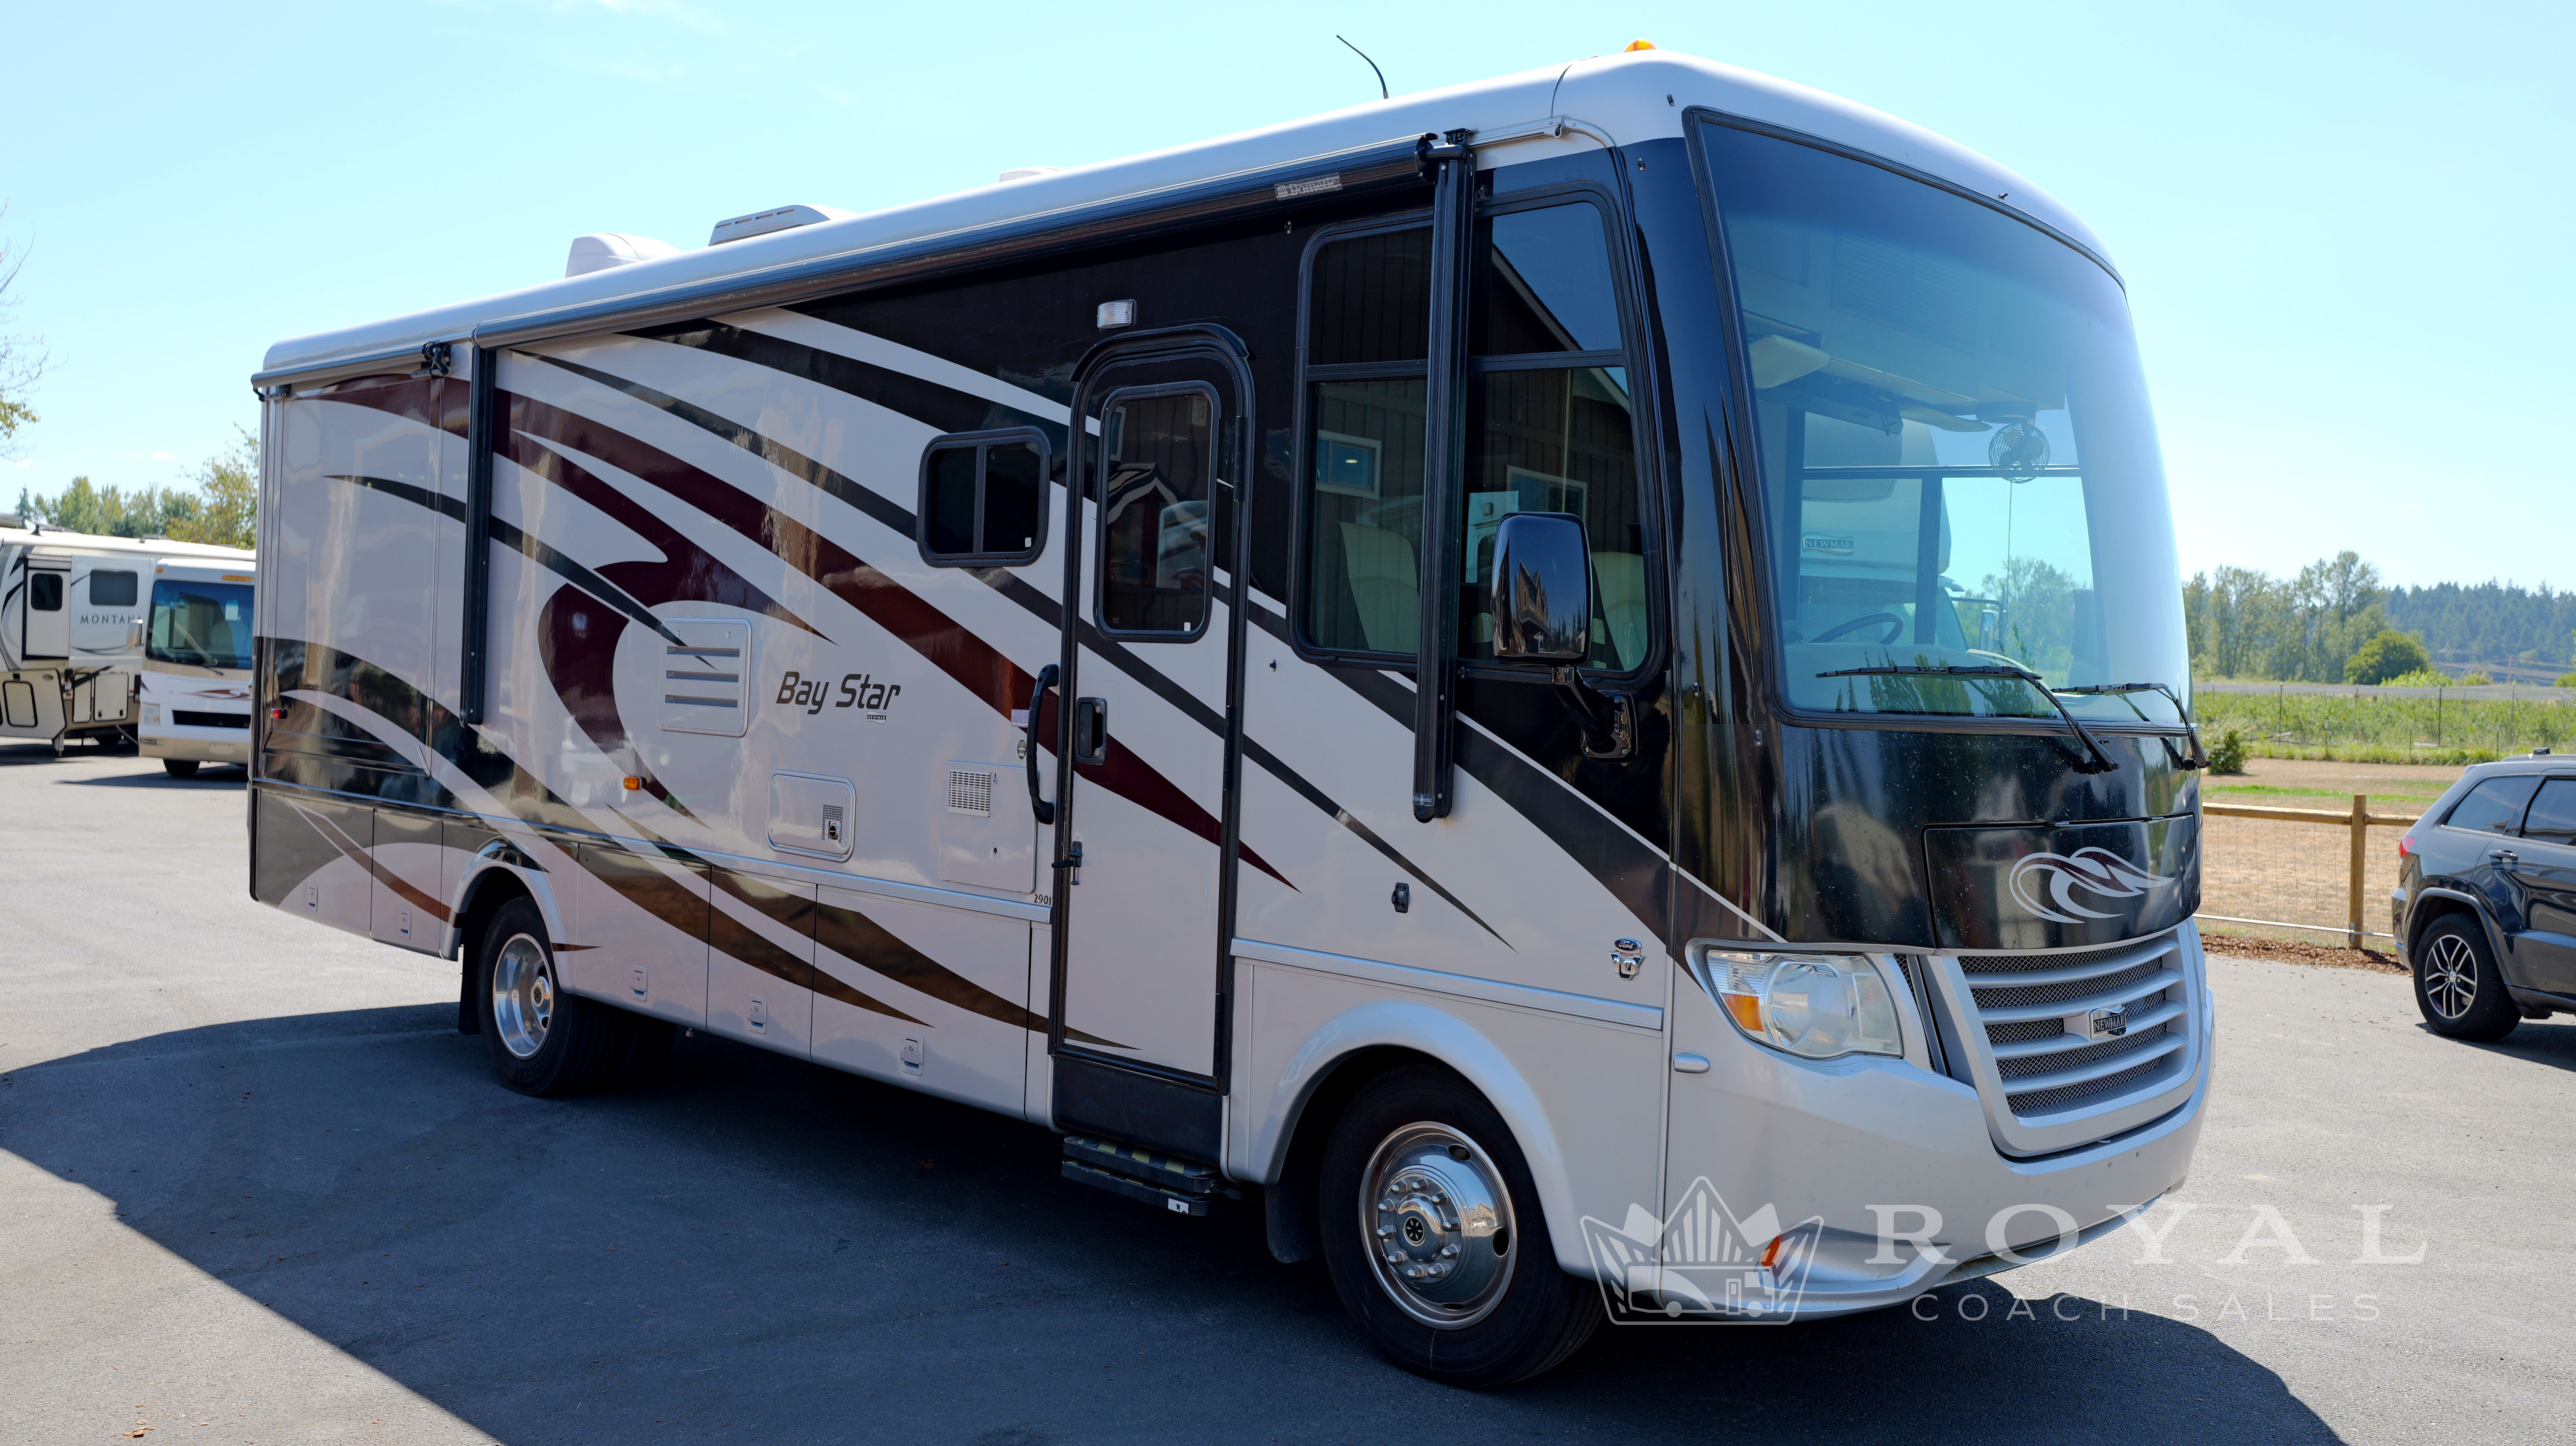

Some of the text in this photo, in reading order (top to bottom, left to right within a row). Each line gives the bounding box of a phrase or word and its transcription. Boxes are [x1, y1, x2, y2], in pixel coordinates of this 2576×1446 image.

[1806, 540, 1852, 548] NEWMAR
[776, 671, 901, 714] Bay Star
[1034, 894, 1051, 905] 2901
[1618, 940, 1634, 949] Ford
[2094, 1015, 2125, 1033] NEWMAR
